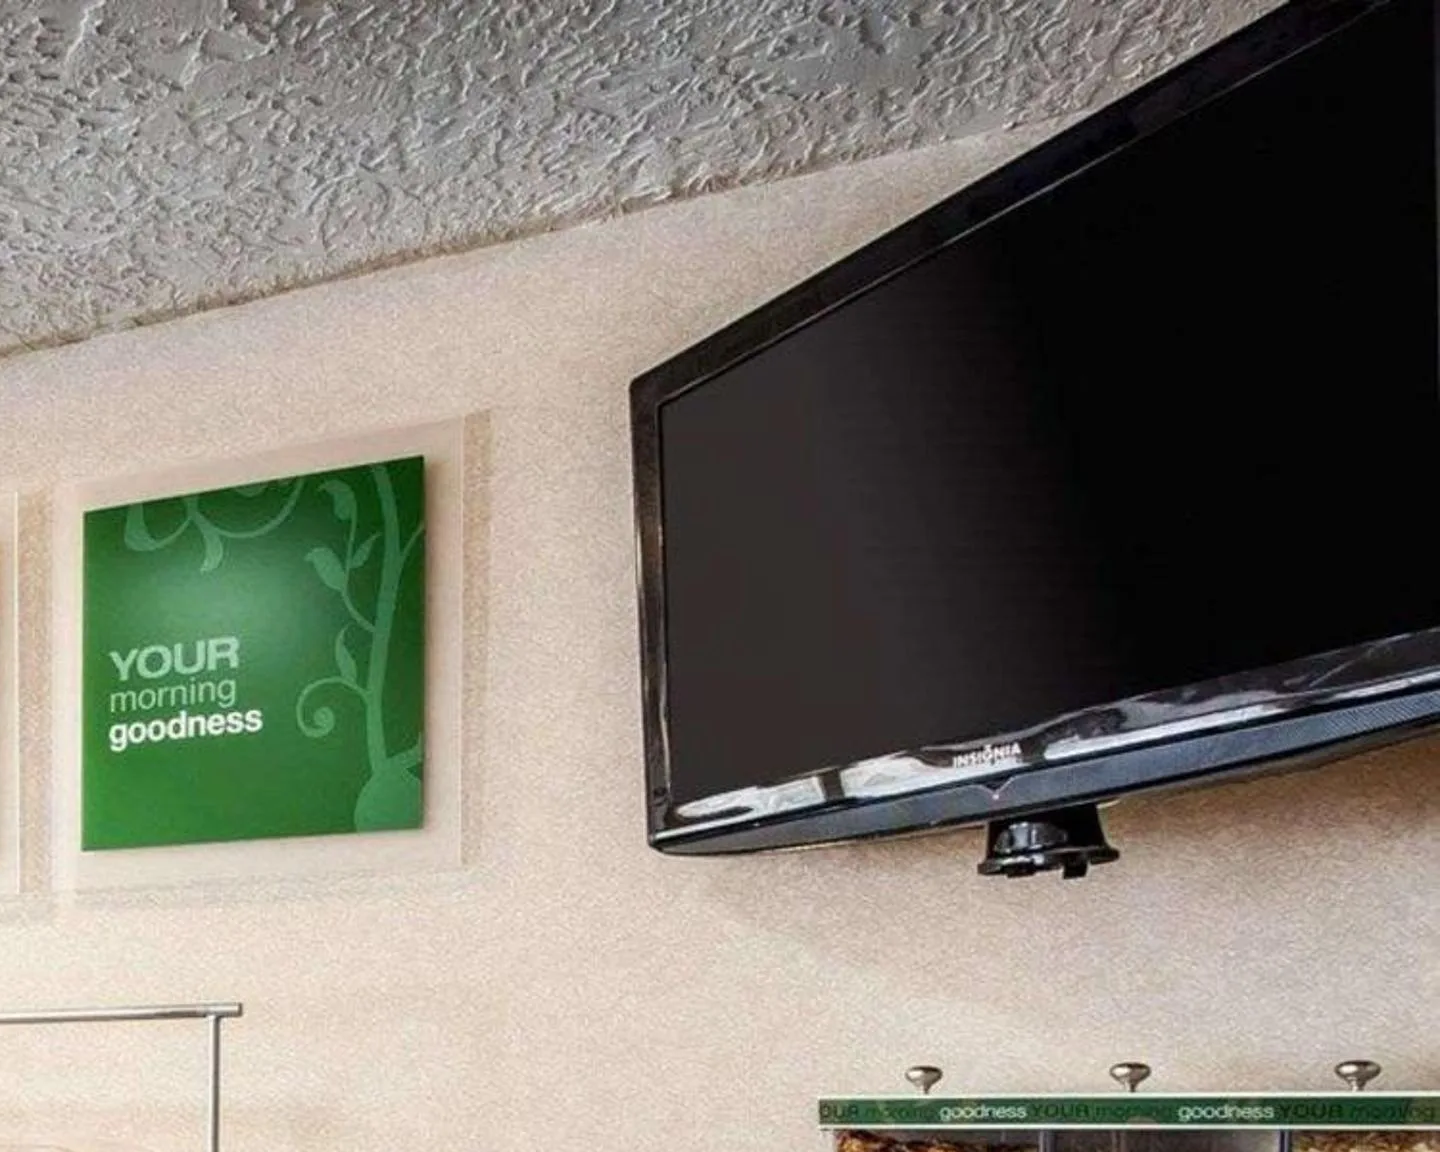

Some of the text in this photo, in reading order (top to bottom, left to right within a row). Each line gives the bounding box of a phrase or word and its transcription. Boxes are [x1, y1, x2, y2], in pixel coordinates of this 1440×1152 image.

[109, 636, 240, 682] YOUR
[110, 677, 237, 713] morning
[109, 709, 264, 753] goodness
[952, 742, 1022, 769] INSIGNIA
[939, 1104, 1027, 1121] goodness
[1032, 1104, 1090, 1119] YOUR
[1177, 1104, 1275, 1121] goodness
[1278, 1103, 1344, 1119] YOUR
